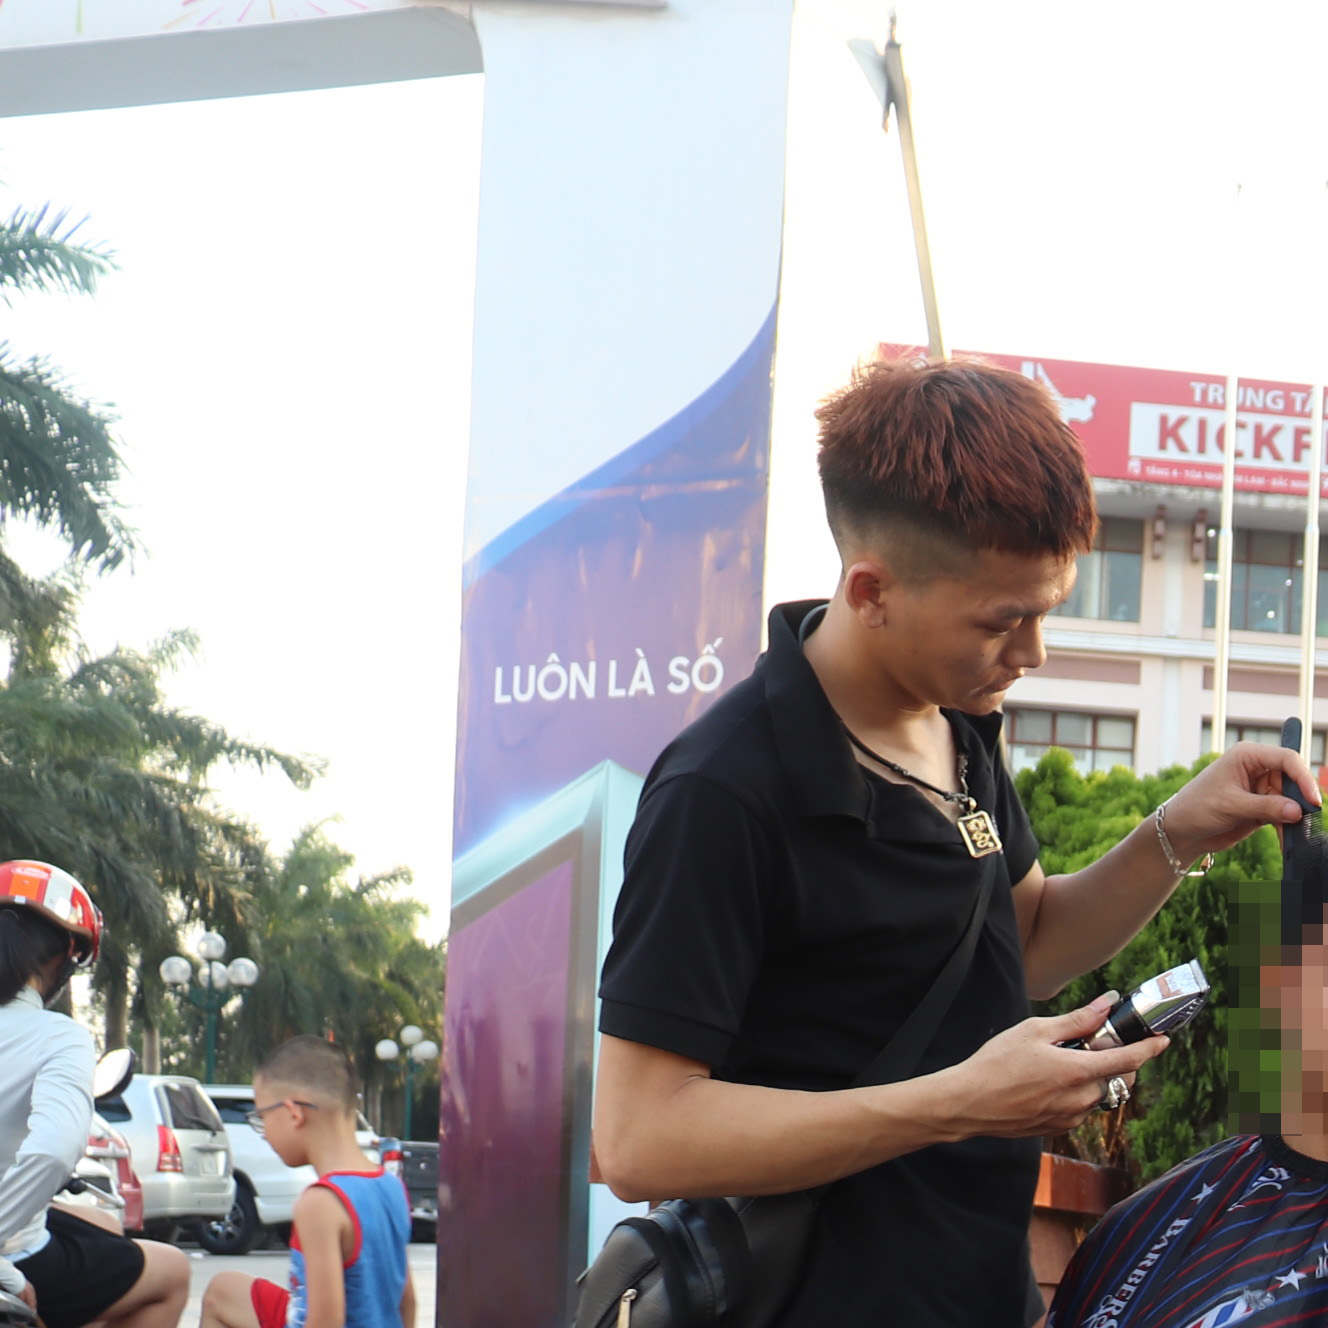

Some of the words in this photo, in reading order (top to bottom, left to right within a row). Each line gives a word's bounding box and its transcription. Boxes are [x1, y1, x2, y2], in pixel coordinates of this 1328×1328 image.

[494, 652, 597, 704] LUÔN
[607, 647, 656, 698] LÀ
[666, 636, 725, 694] SỐ
